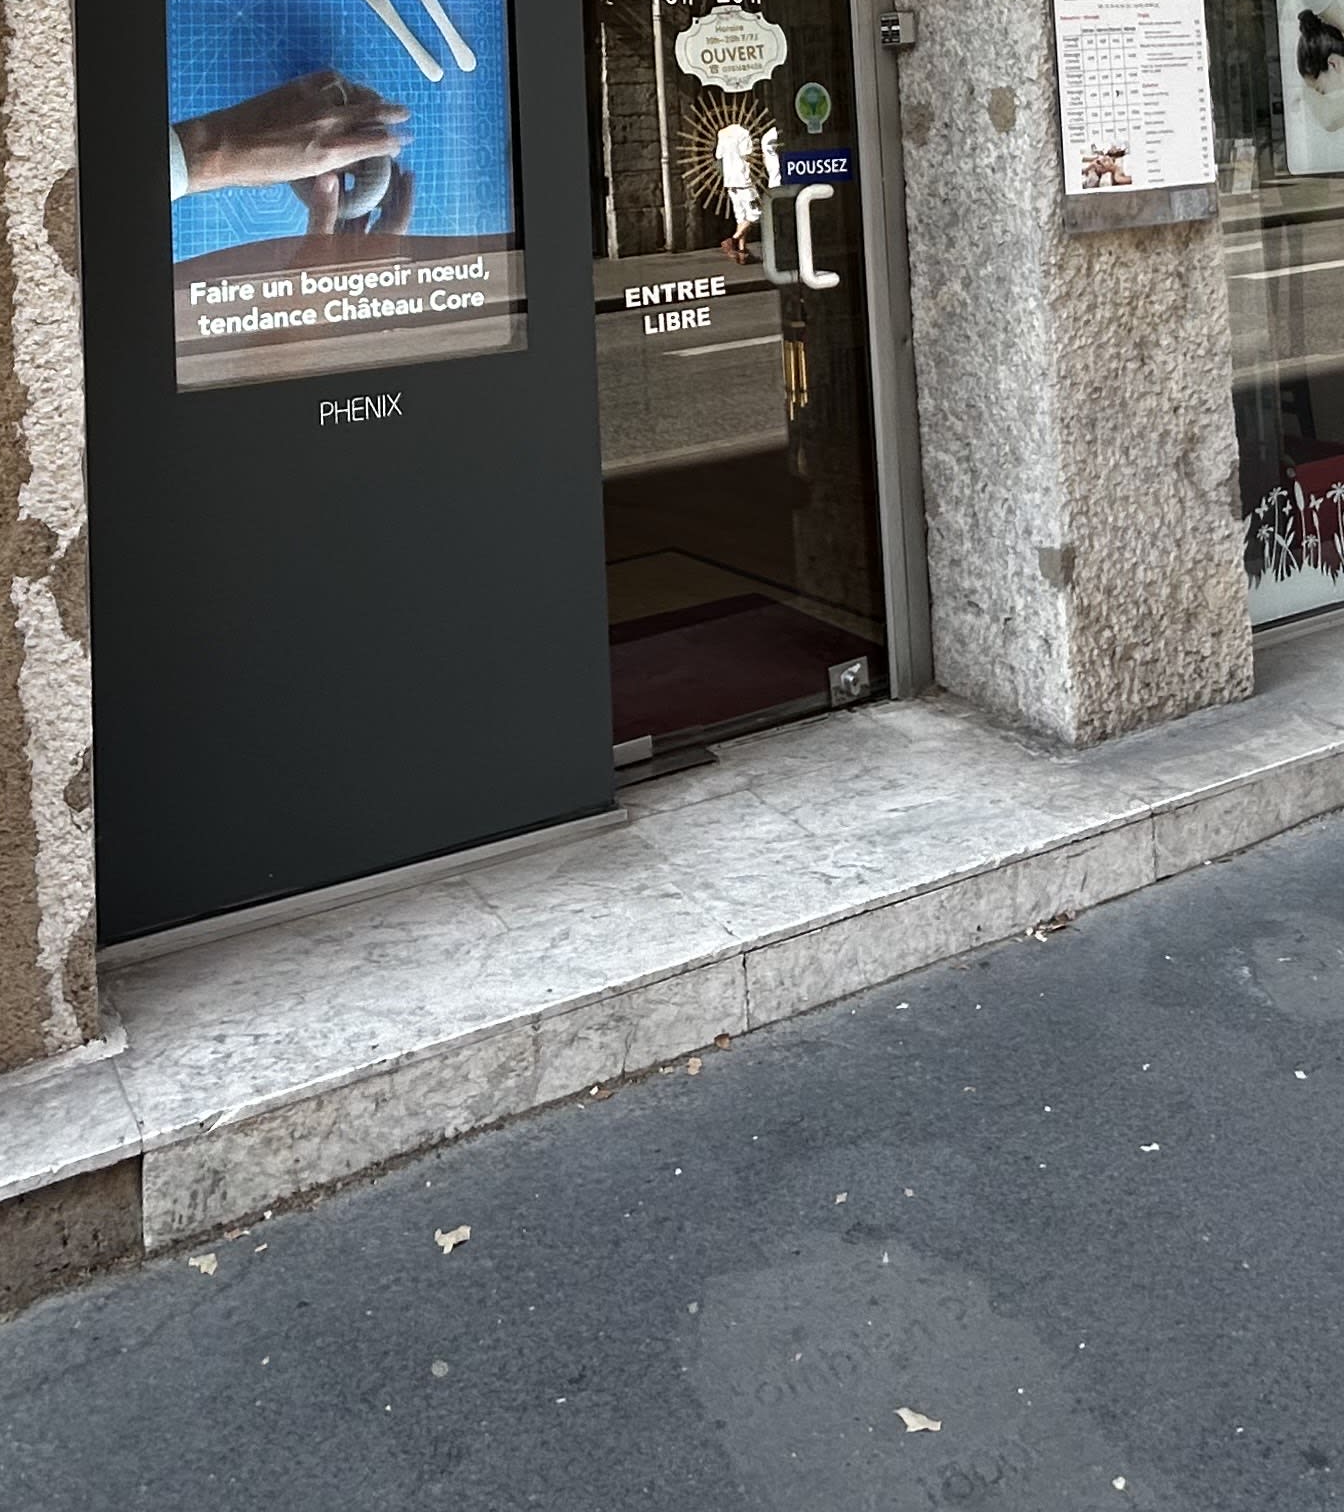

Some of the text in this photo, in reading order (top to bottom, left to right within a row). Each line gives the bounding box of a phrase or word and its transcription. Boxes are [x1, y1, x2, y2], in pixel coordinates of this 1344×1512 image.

[701, 44, 765, 64] OUVERT
[787, 158, 848, 176] POUSSEZ
[189, 256, 490, 306] Faire un bougeoir nœud,
[625, 275, 726, 308] ENTREE
[198, 289, 485, 336] tendance Château Core
[644, 306, 711, 336] LIBRE
[319, 392, 403, 426] PHENIX
